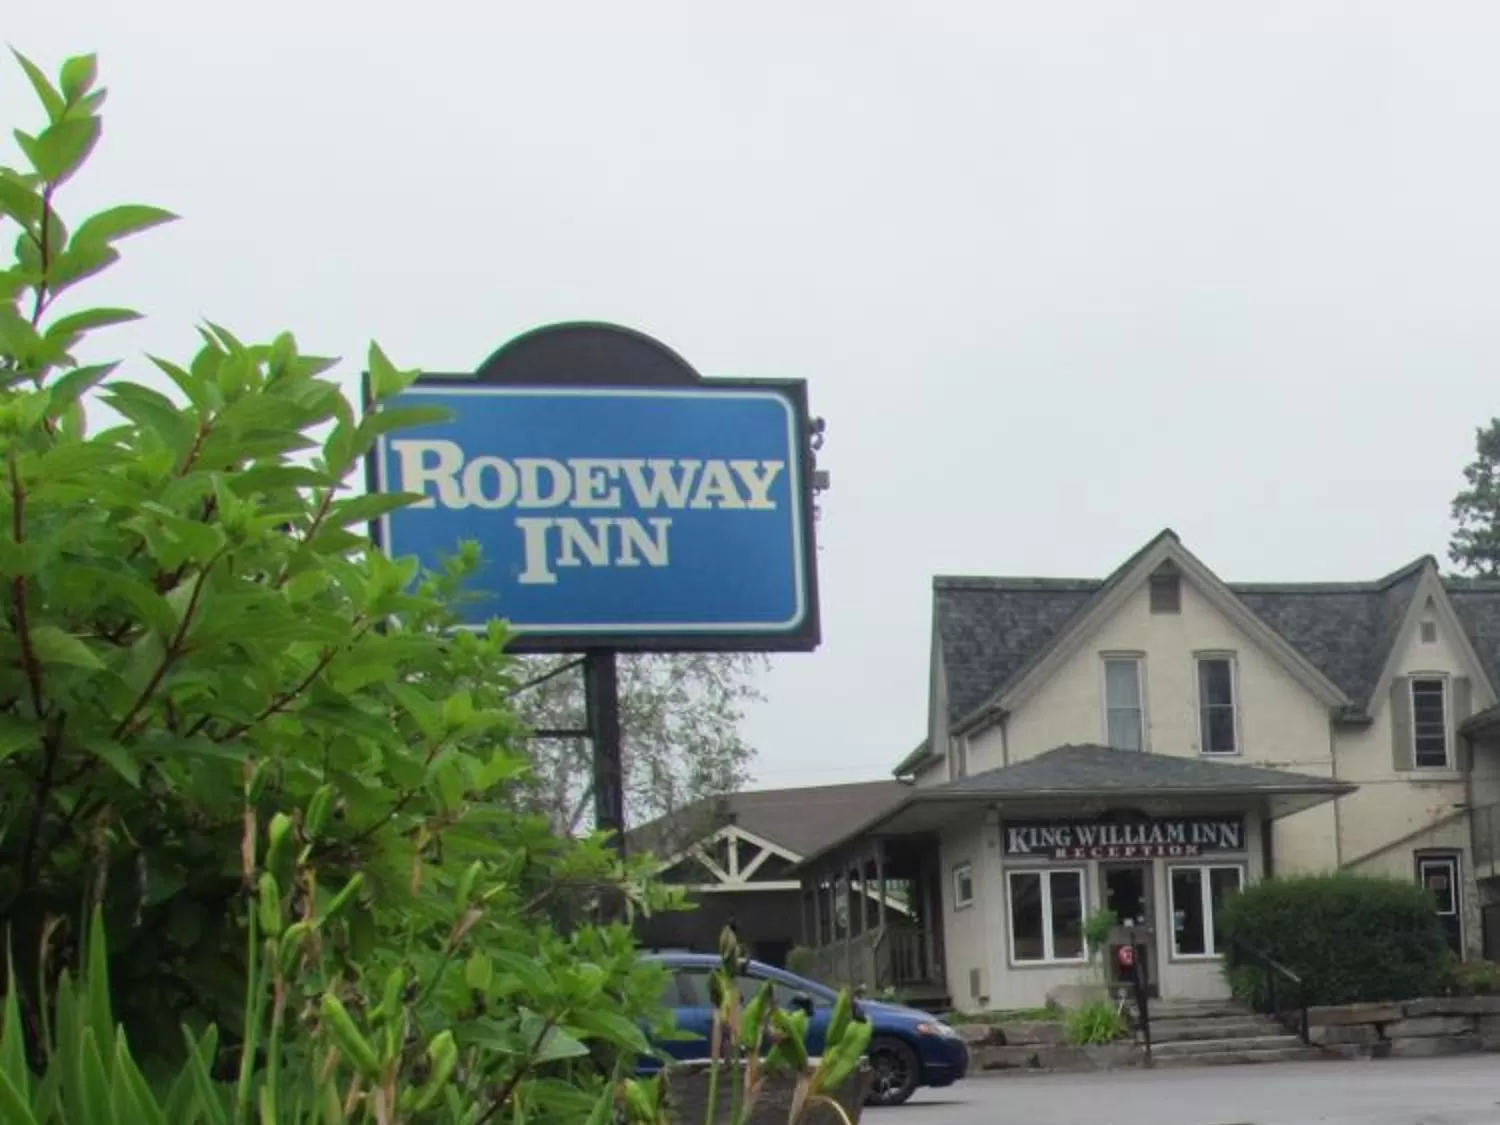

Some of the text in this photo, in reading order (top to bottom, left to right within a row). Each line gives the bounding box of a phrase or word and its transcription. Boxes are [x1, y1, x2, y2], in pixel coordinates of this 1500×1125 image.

[391, 439, 785, 510] RODEWAY
[515, 517, 673, 584] INN
[1007, 821, 1240, 853] KING WILLIAM INN
[1055, 845, 1199, 858] RECEPTION
